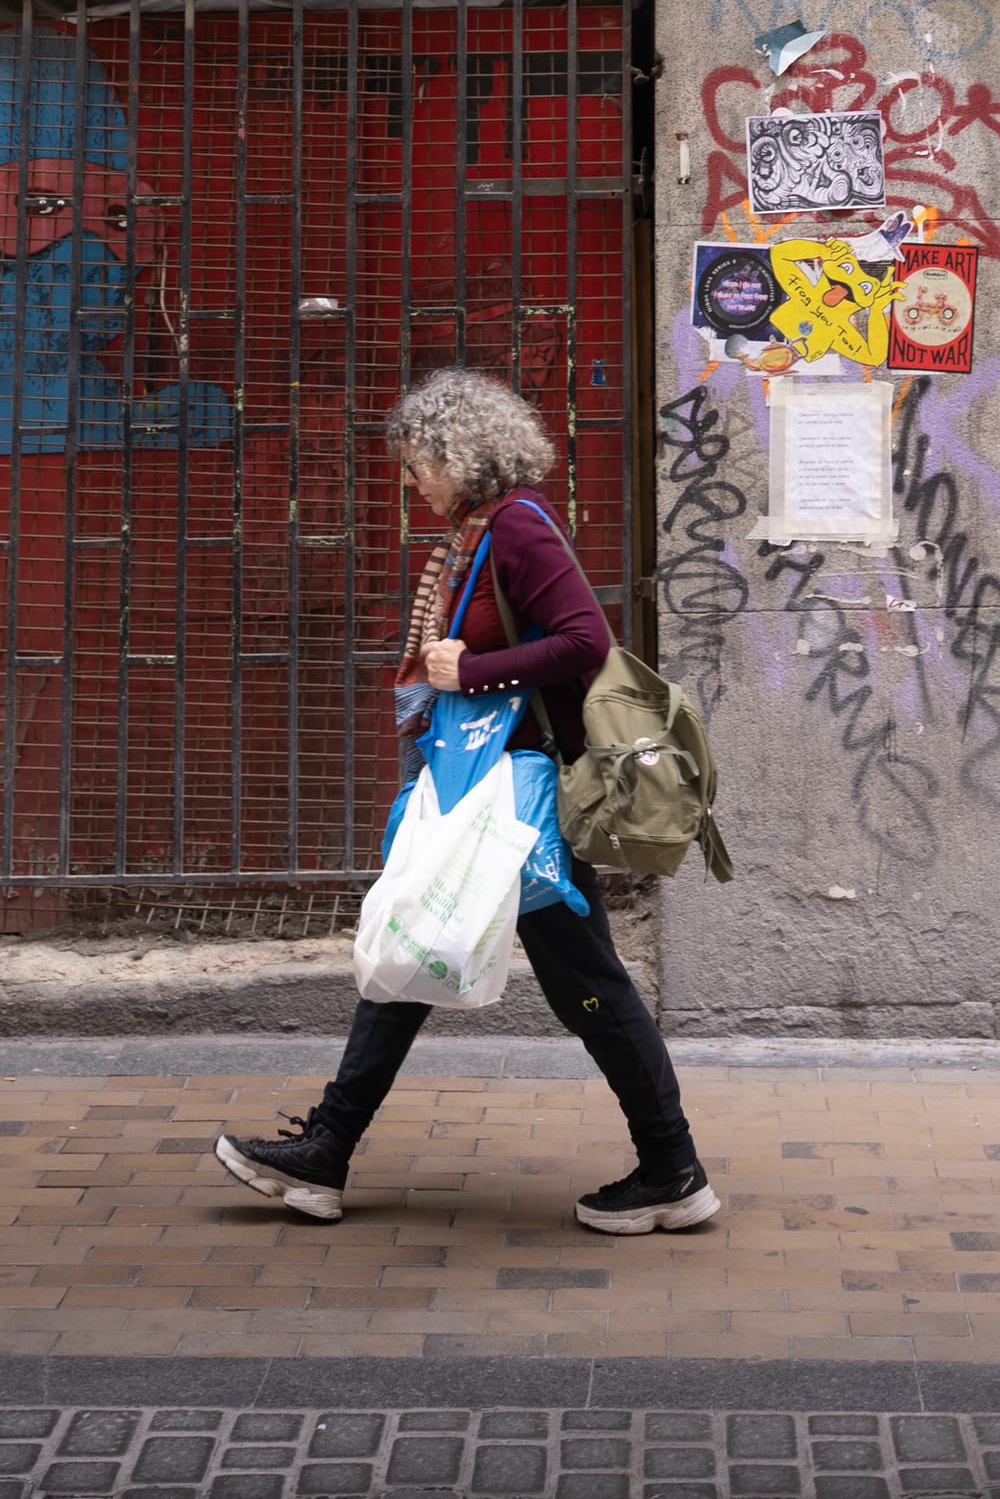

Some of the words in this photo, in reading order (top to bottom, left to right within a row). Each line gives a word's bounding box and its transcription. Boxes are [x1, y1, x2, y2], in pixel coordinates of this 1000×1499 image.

[897, 249, 939, 281] MAKE
[945, 252, 975, 284] ART
[892, 329, 928, 363] NOT
[931, 331, 969, 366] WAR
